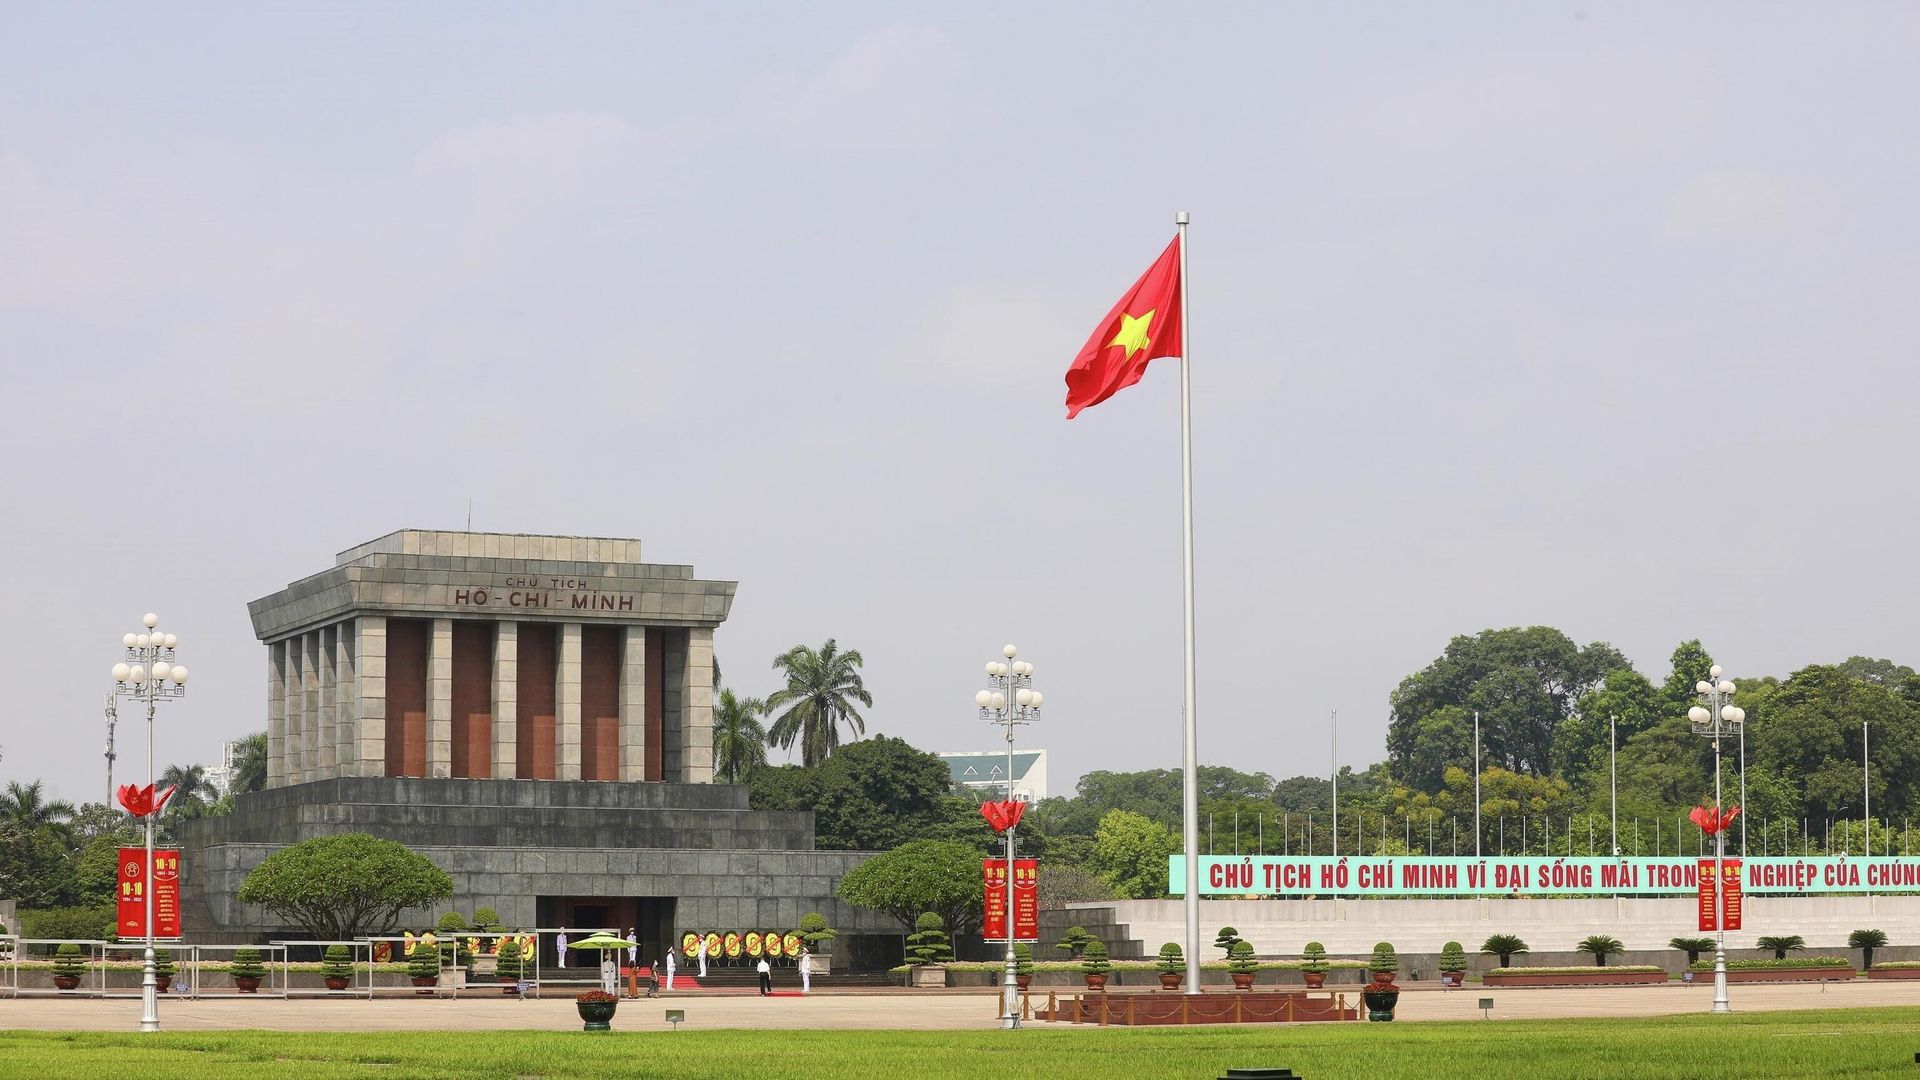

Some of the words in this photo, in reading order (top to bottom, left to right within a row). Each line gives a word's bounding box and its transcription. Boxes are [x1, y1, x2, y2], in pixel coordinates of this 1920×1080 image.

[1209, 857, 1254, 889] CHỦ
[1262, 863, 1311, 893] TỊCH
[1320, 857, 1350, 889] HỒ
[1357, 859, 1393, 889] CHÍ
[1402, 864, 1458, 889] MINH
[1466, 859, 1487, 889] VĨ
[1494, 864, 1529, 893] ĐẠI
[1538, 858, 1593, 889] SỐNG
[1600, 859, 1638, 888] MÃI
[1749, 859, 1818, 891] NGHIỆP
[1824, 857, 1860, 887] CỦA
